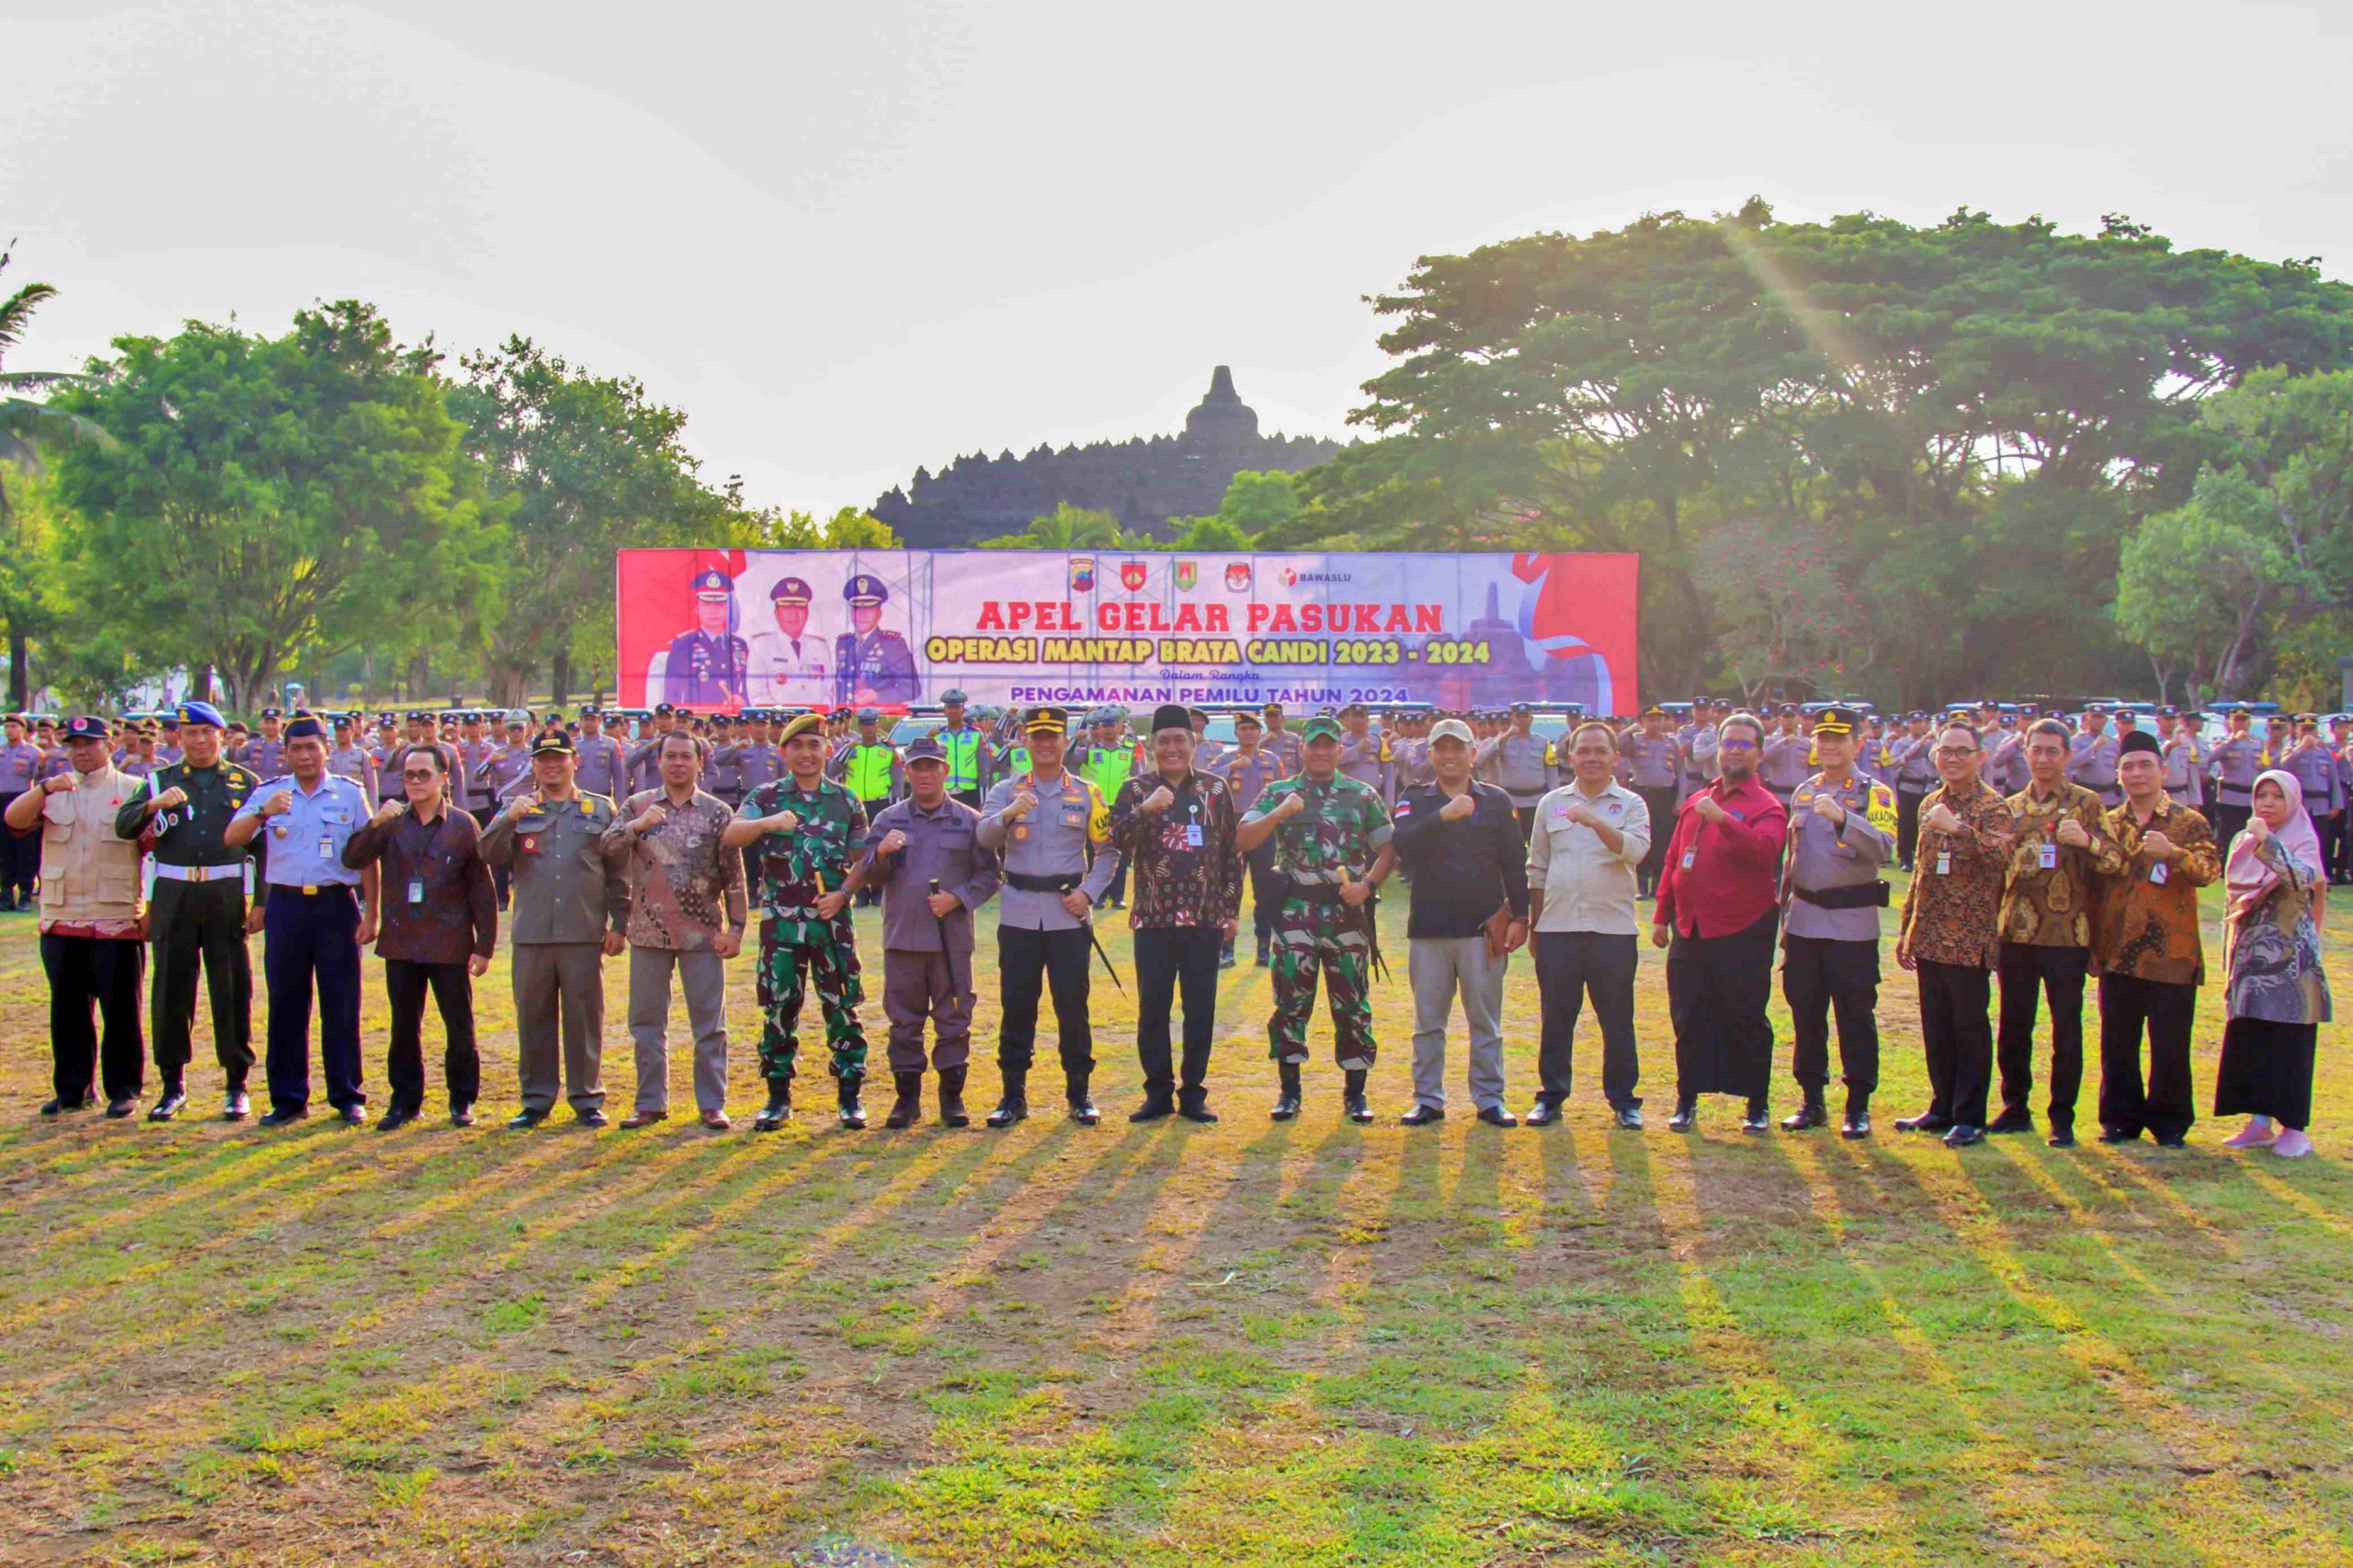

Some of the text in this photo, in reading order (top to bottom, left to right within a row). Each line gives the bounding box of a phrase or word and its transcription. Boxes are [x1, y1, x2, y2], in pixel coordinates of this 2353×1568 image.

[1300, 574, 1351, 582] BAWASLU
[976, 601, 1442, 632] APEL GELAR PASUKAN
[926, 637, 1037, 663] OPERASI
[1042, 638, 1154, 664] MANTAP
[1160, 639, 1242, 664] BRATA
[1246, 640, 1328, 665] CANDI
[1335, 641, 1400, 665] 2023
[1426, 641, 1491, 665] 2024
[1159, 669, 1260, 684] Dalam Rangka
[1011, 687, 1408, 703] PENGAMANAN PEMILU TAHUN 2024
